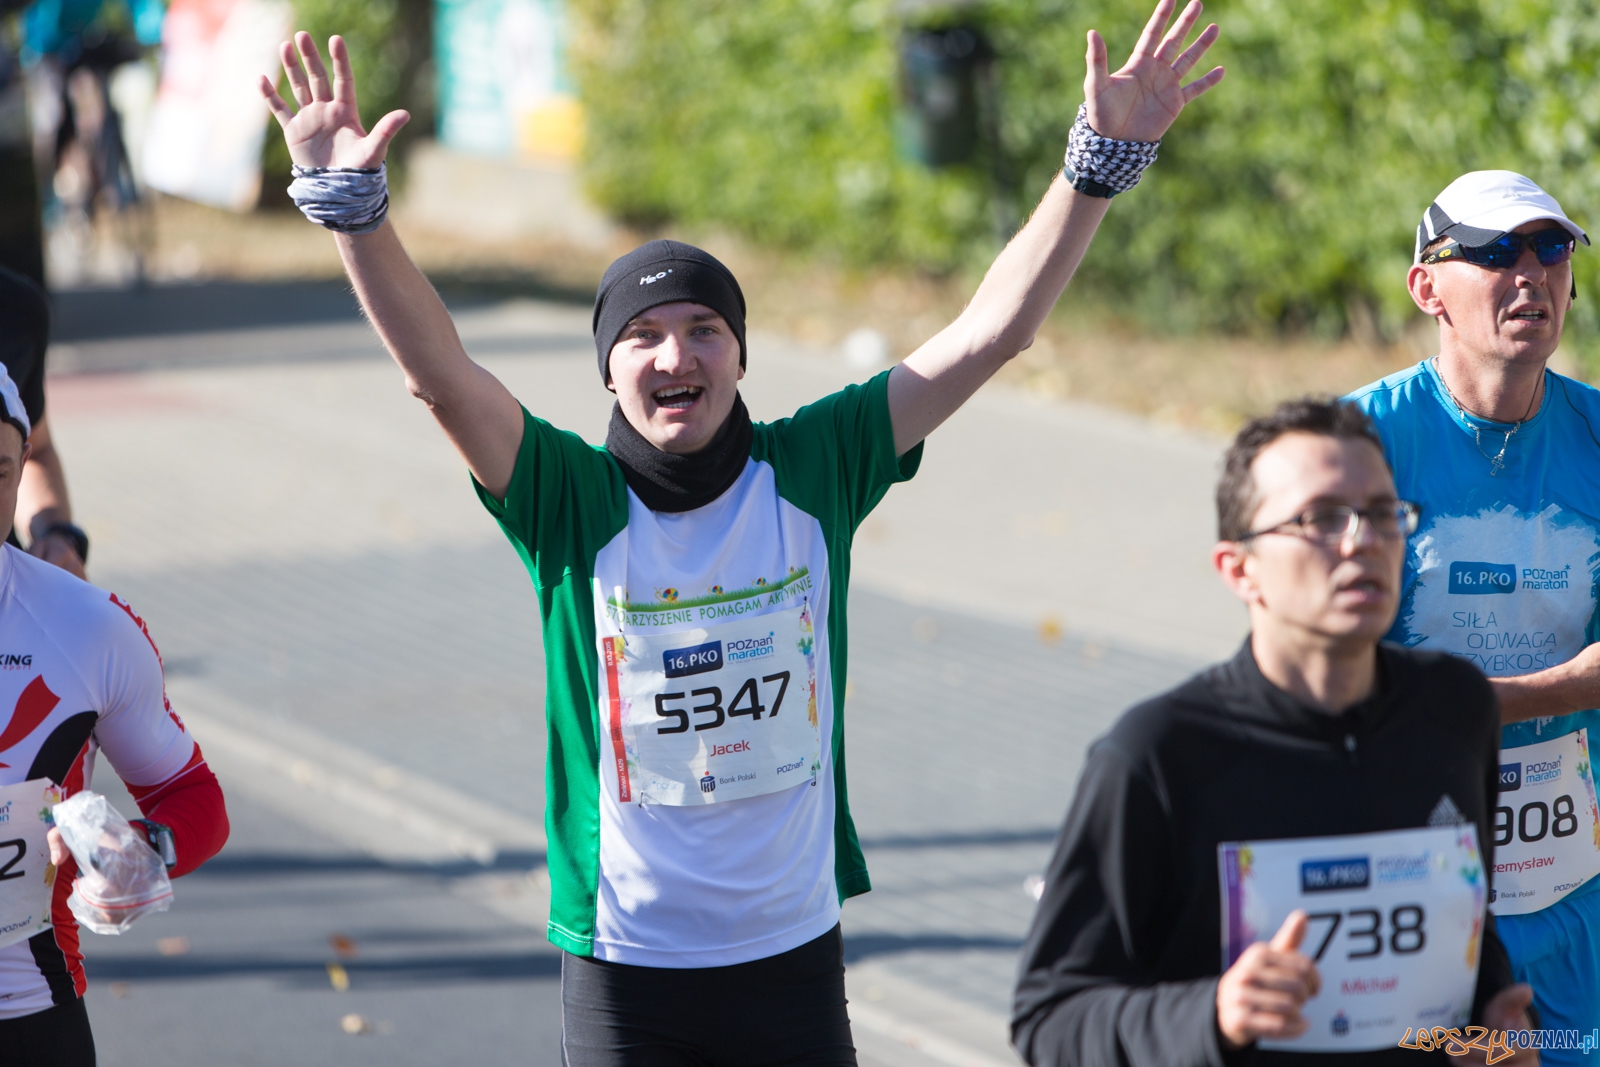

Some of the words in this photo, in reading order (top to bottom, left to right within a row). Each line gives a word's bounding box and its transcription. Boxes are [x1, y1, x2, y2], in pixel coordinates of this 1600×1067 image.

[1455, 571, 1476, 585] 16.
[1479, 571, 1511, 586] PKO
[1522, 580, 1569, 590] maraton
[605, 605, 692, 627] STOARZYSZENIE
[699, 599, 762, 620] POMAGAM
[1452, 611, 1498, 629] SIŁA
[1467, 632, 1557, 650] ODWAGA
[668, 656, 687, 670] 16.
[689, 649, 718, 667] PKO
[727, 645, 775, 662] maraton
[1450, 649, 1556, 671] ZYBKOŚĆ
[654, 670, 791, 735] 5347
[709, 739, 751, 757] Jacek
[719, 776, 736, 785] Bank
[737, 772, 757, 782] Polski
[1499, 771, 1517, 784] KO
[1525, 768, 1562, 783] maraton
[1329, 862, 1367, 884] PKO
[1492, 856, 1555, 873] zemysław
[1306, 902, 1426, 962] 738
